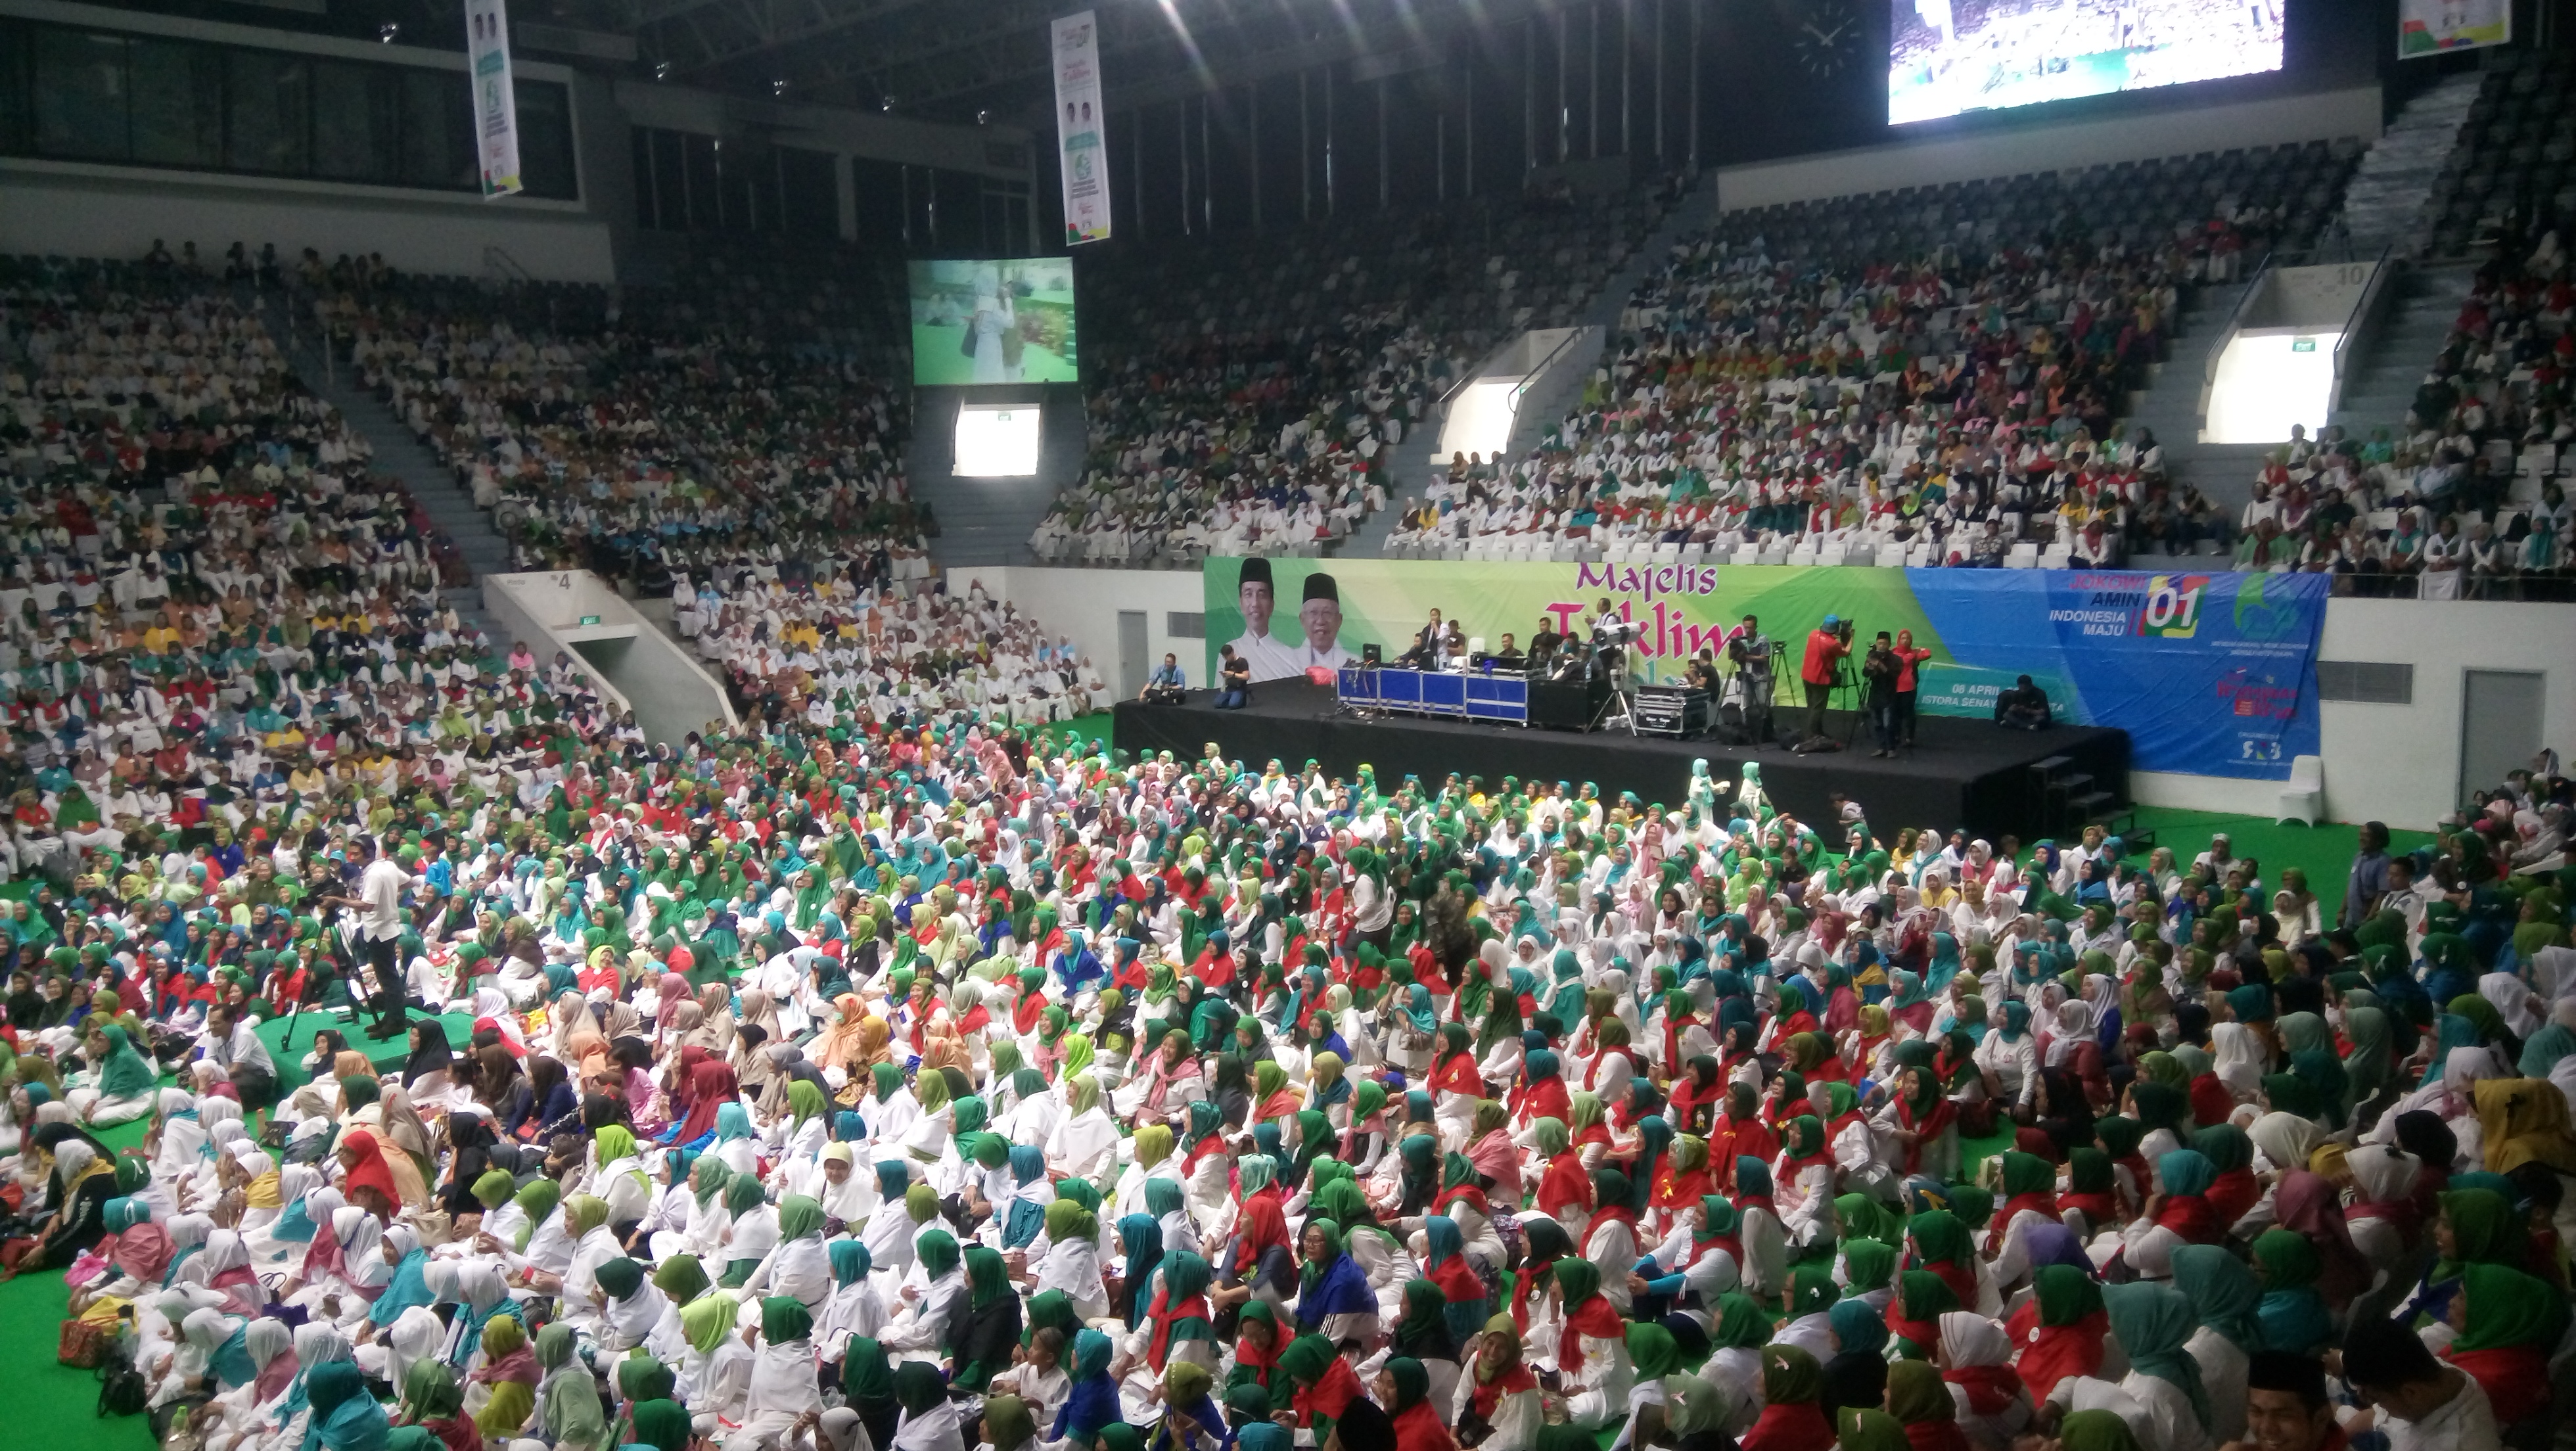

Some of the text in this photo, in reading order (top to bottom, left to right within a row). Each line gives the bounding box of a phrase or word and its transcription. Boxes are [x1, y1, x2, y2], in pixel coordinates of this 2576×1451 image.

[2338, 265, 2364, 285] 10
[559, 573, 570, 589] 4
[1576, 562, 1716, 603] Majelis
[2070, 574, 2146, 589] JOKOWI
[2090, 591, 2141, 607] AMIN
[2146, 586, 2200, 628] 01
[2048, 609, 2127, 624] INDONESIA
[1546, 601, 1747, 659] Tklim
[2082, 624, 2125, 636] MAJU
[1967, 684, 2000, 696] APRIL
[1921, 695, 1997, 708] ISTORA SENAY
